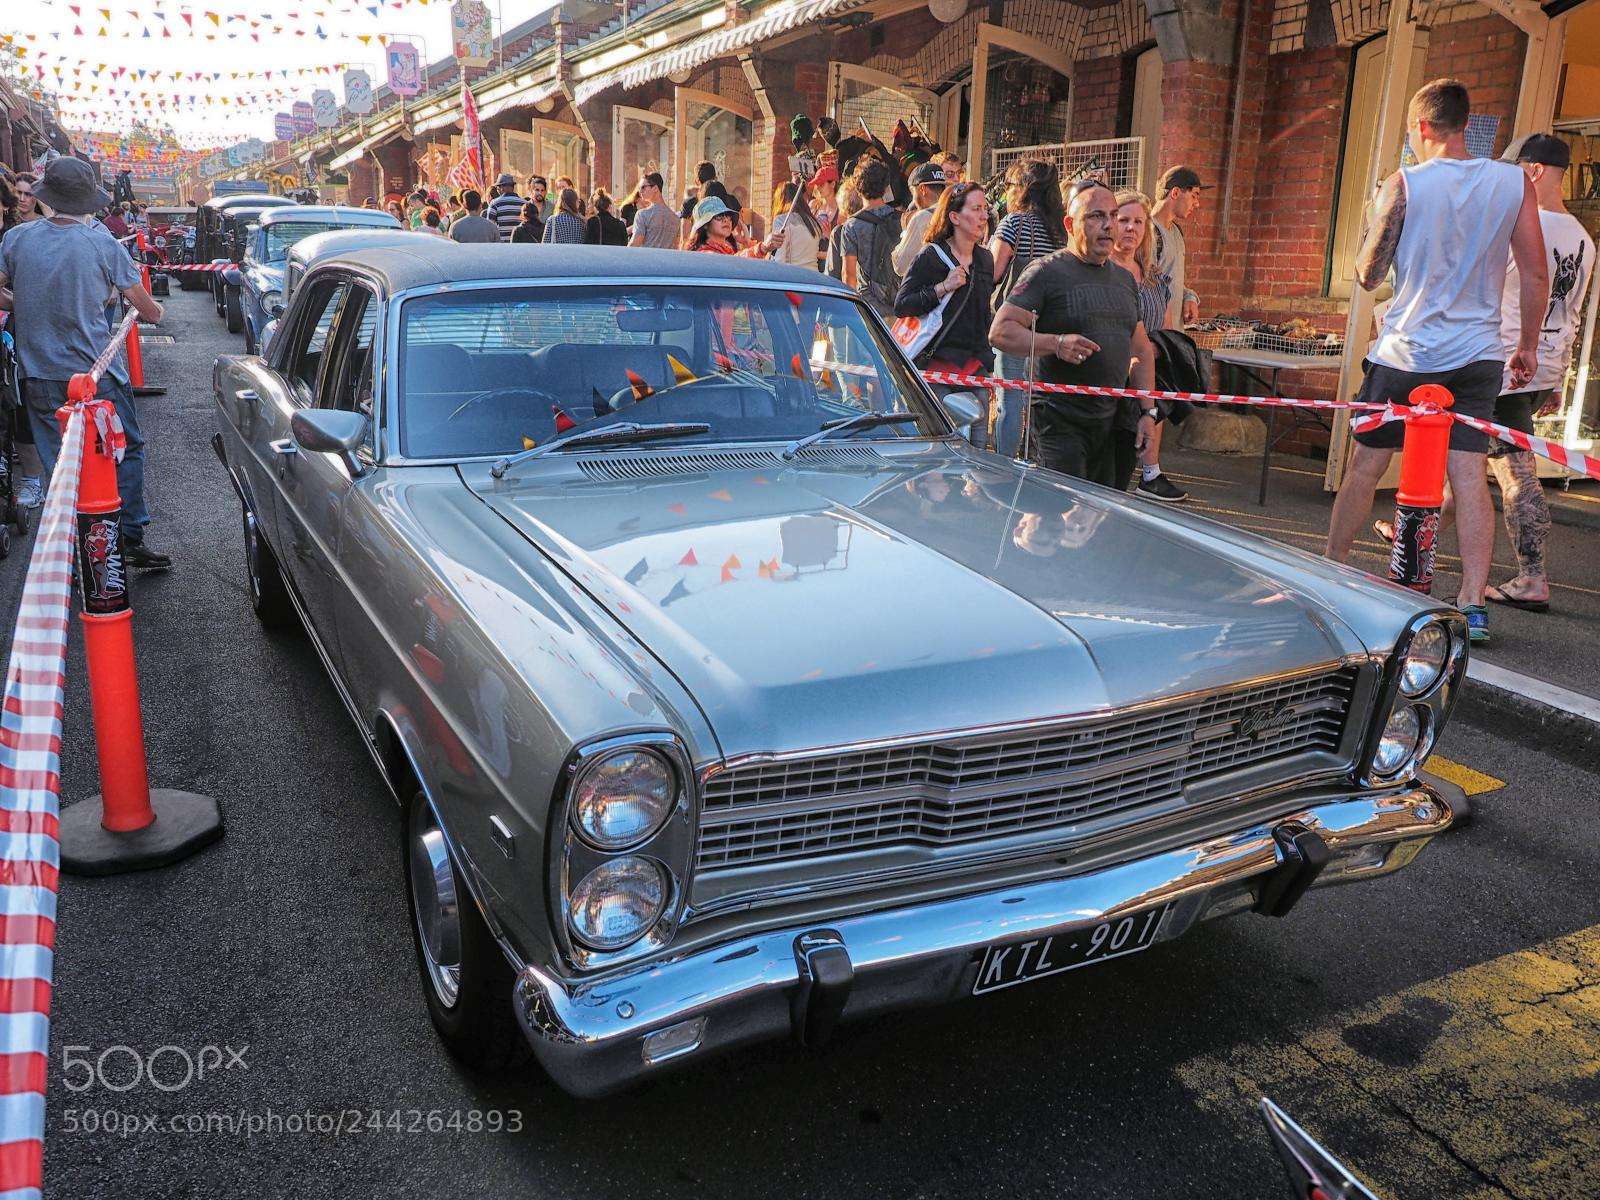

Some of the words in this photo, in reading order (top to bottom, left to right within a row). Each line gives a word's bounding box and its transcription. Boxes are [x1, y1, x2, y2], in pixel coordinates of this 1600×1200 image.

[106, 554, 126, 592] Wolf
[984, 937, 1053, 985] KTL
[1086, 911, 1152, 957] 901
